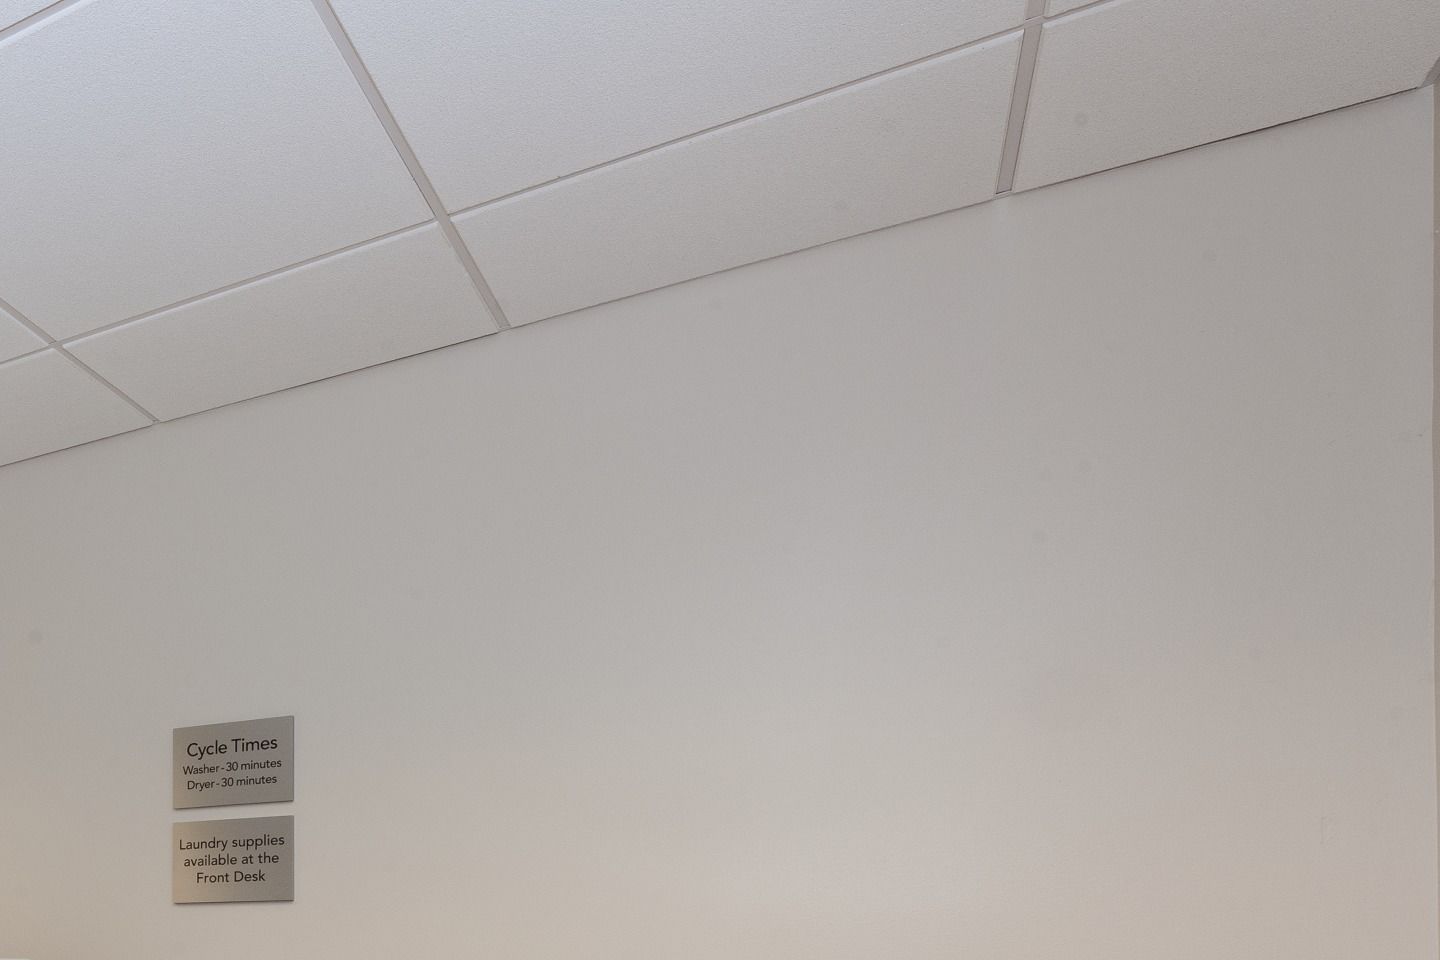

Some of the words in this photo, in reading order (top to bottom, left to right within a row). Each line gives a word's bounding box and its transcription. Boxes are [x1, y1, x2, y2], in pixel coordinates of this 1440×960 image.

[187, 740, 228, 760] Cycle
[231, 738, 278, 753] Times
[183, 764, 220, 775] Washer
[226, 761, 238, 772] 30
[240, 759, 282, 771] minutes
[187, 780, 215, 791] Dryer
[221, 777, 234, 787] 30
[236, 776, 278, 786] minutes
[179, 836, 228, 851] Laundry
[232, 834, 285, 850] supplies
[184, 853, 237, 867] available
[241, 854, 254, 865] at
[258, 852, 279, 864] the
[196, 872, 229, 883] Front
[234, 870, 266, 882] Desk
